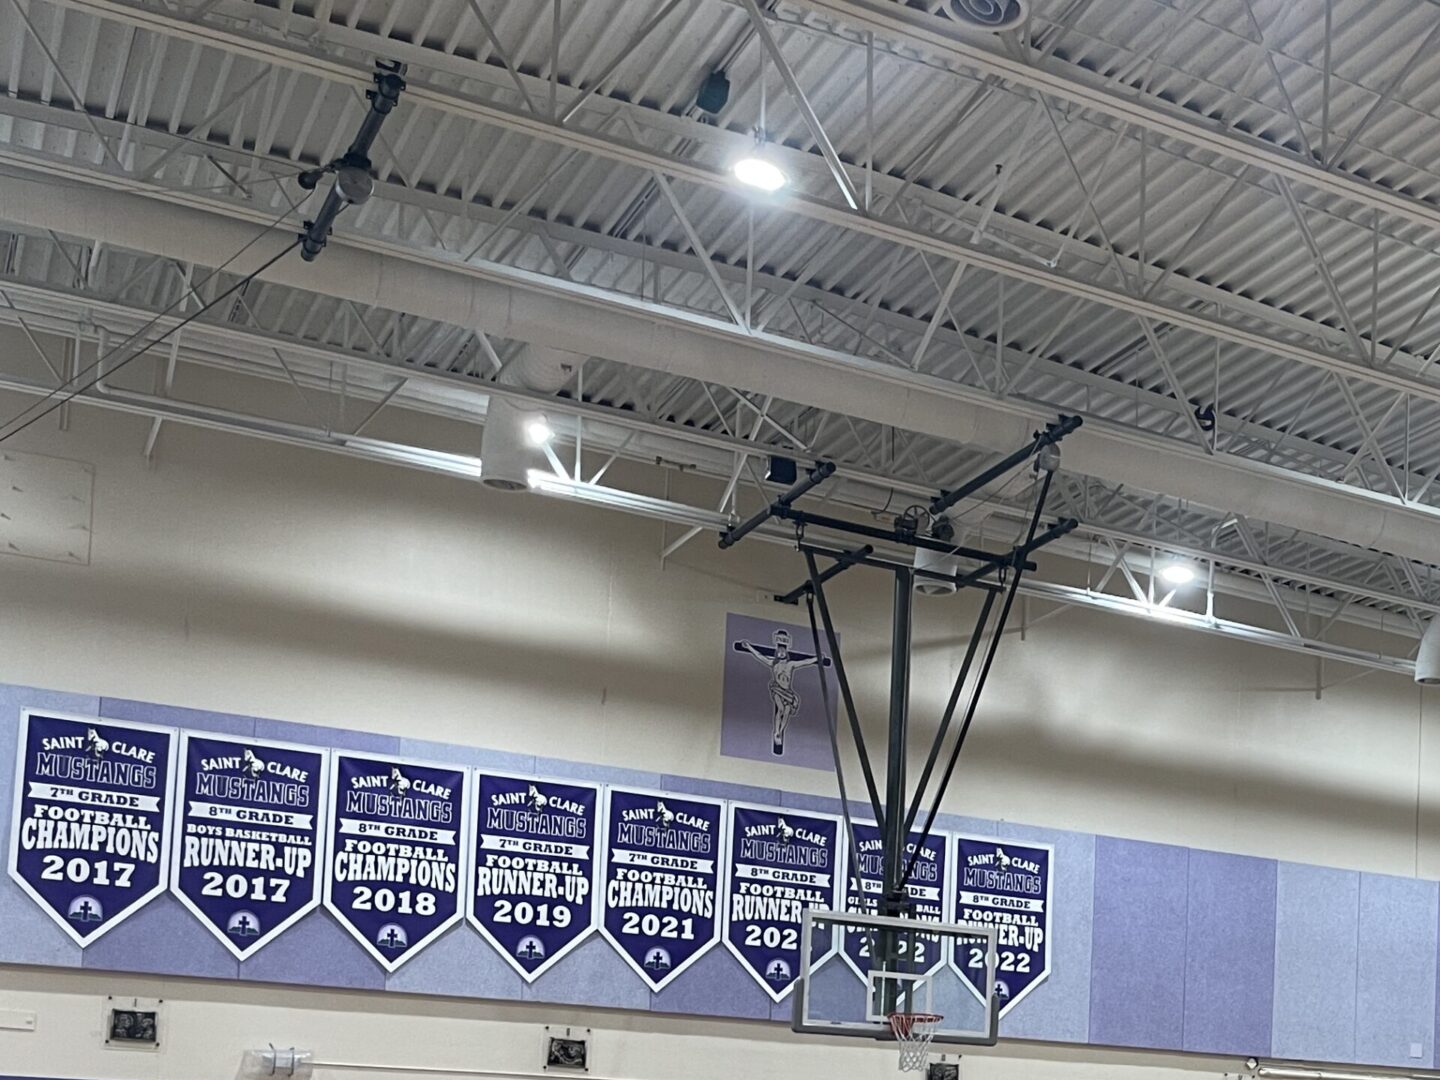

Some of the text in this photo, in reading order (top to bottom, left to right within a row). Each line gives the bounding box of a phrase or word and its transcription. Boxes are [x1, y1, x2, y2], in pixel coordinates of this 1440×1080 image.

[42, 736, 156, 763] SAINT CLARE
[36, 752, 157, 789] MUSTANGS
[201, 756, 308, 782] SAINT CLARE
[78, 791, 139, 807] GRADE
[195, 772, 310, 807] MUSTANGS
[351, 775, 451, 800] SAINT CLARE
[33, 804, 151, 830] FOOTBALL
[236, 809, 294, 826] GRADE
[346, 790, 453, 823] MUSTANGS
[491, 793, 586, 816] SAINT CLARE
[486, 807, 587, 839] MUSTANGS
[622, 808, 711, 832] SAINT CLARE
[21, 817, 159, 864] CHAMPIONS
[187, 823, 312, 846] BOYS BASKETBALL
[384, 826, 438, 841] GRADE
[617, 822, 711, 854] MUSTANGS
[745, 825, 827, 847] SAINT CLARE
[859, 840, 883, 852] SAIN
[183, 835, 312, 878] RUNNER-UP
[345, 839, 448, 862] FOOTBALL
[522, 840, 574, 856] GRADE
[740, 838, 828, 868] MUSTANGS
[40, 855, 136, 888] 2017
[334, 851, 456, 893] CHAMPIONS
[485, 854, 583, 876] FOOTBALL
[650, 856, 698, 870] GRADE
[967, 854, 1040, 874] SAINT CLARE
[201, 871, 291, 903] 2017
[477, 866, 590, 906] RUNNER-UP
[616, 868, 708, 889] FOOTBALL
[772, 870, 816, 883] GRADE
[963, 867, 1041, 895] MUSTANGS
[352, 886, 436, 916] 2018
[607, 879, 714, 919] CHAMPIONS
[739, 882, 825, 903] FOOTBALL
[992, 897, 1031, 909] GRADE
[492, 900, 572, 928] 2019
[621, 911, 695, 940] 2021
[963, 908, 1039, 927] FOOTBALL
[744, 924, 800, 951] 202
[858, 937, 925, 963] 222
